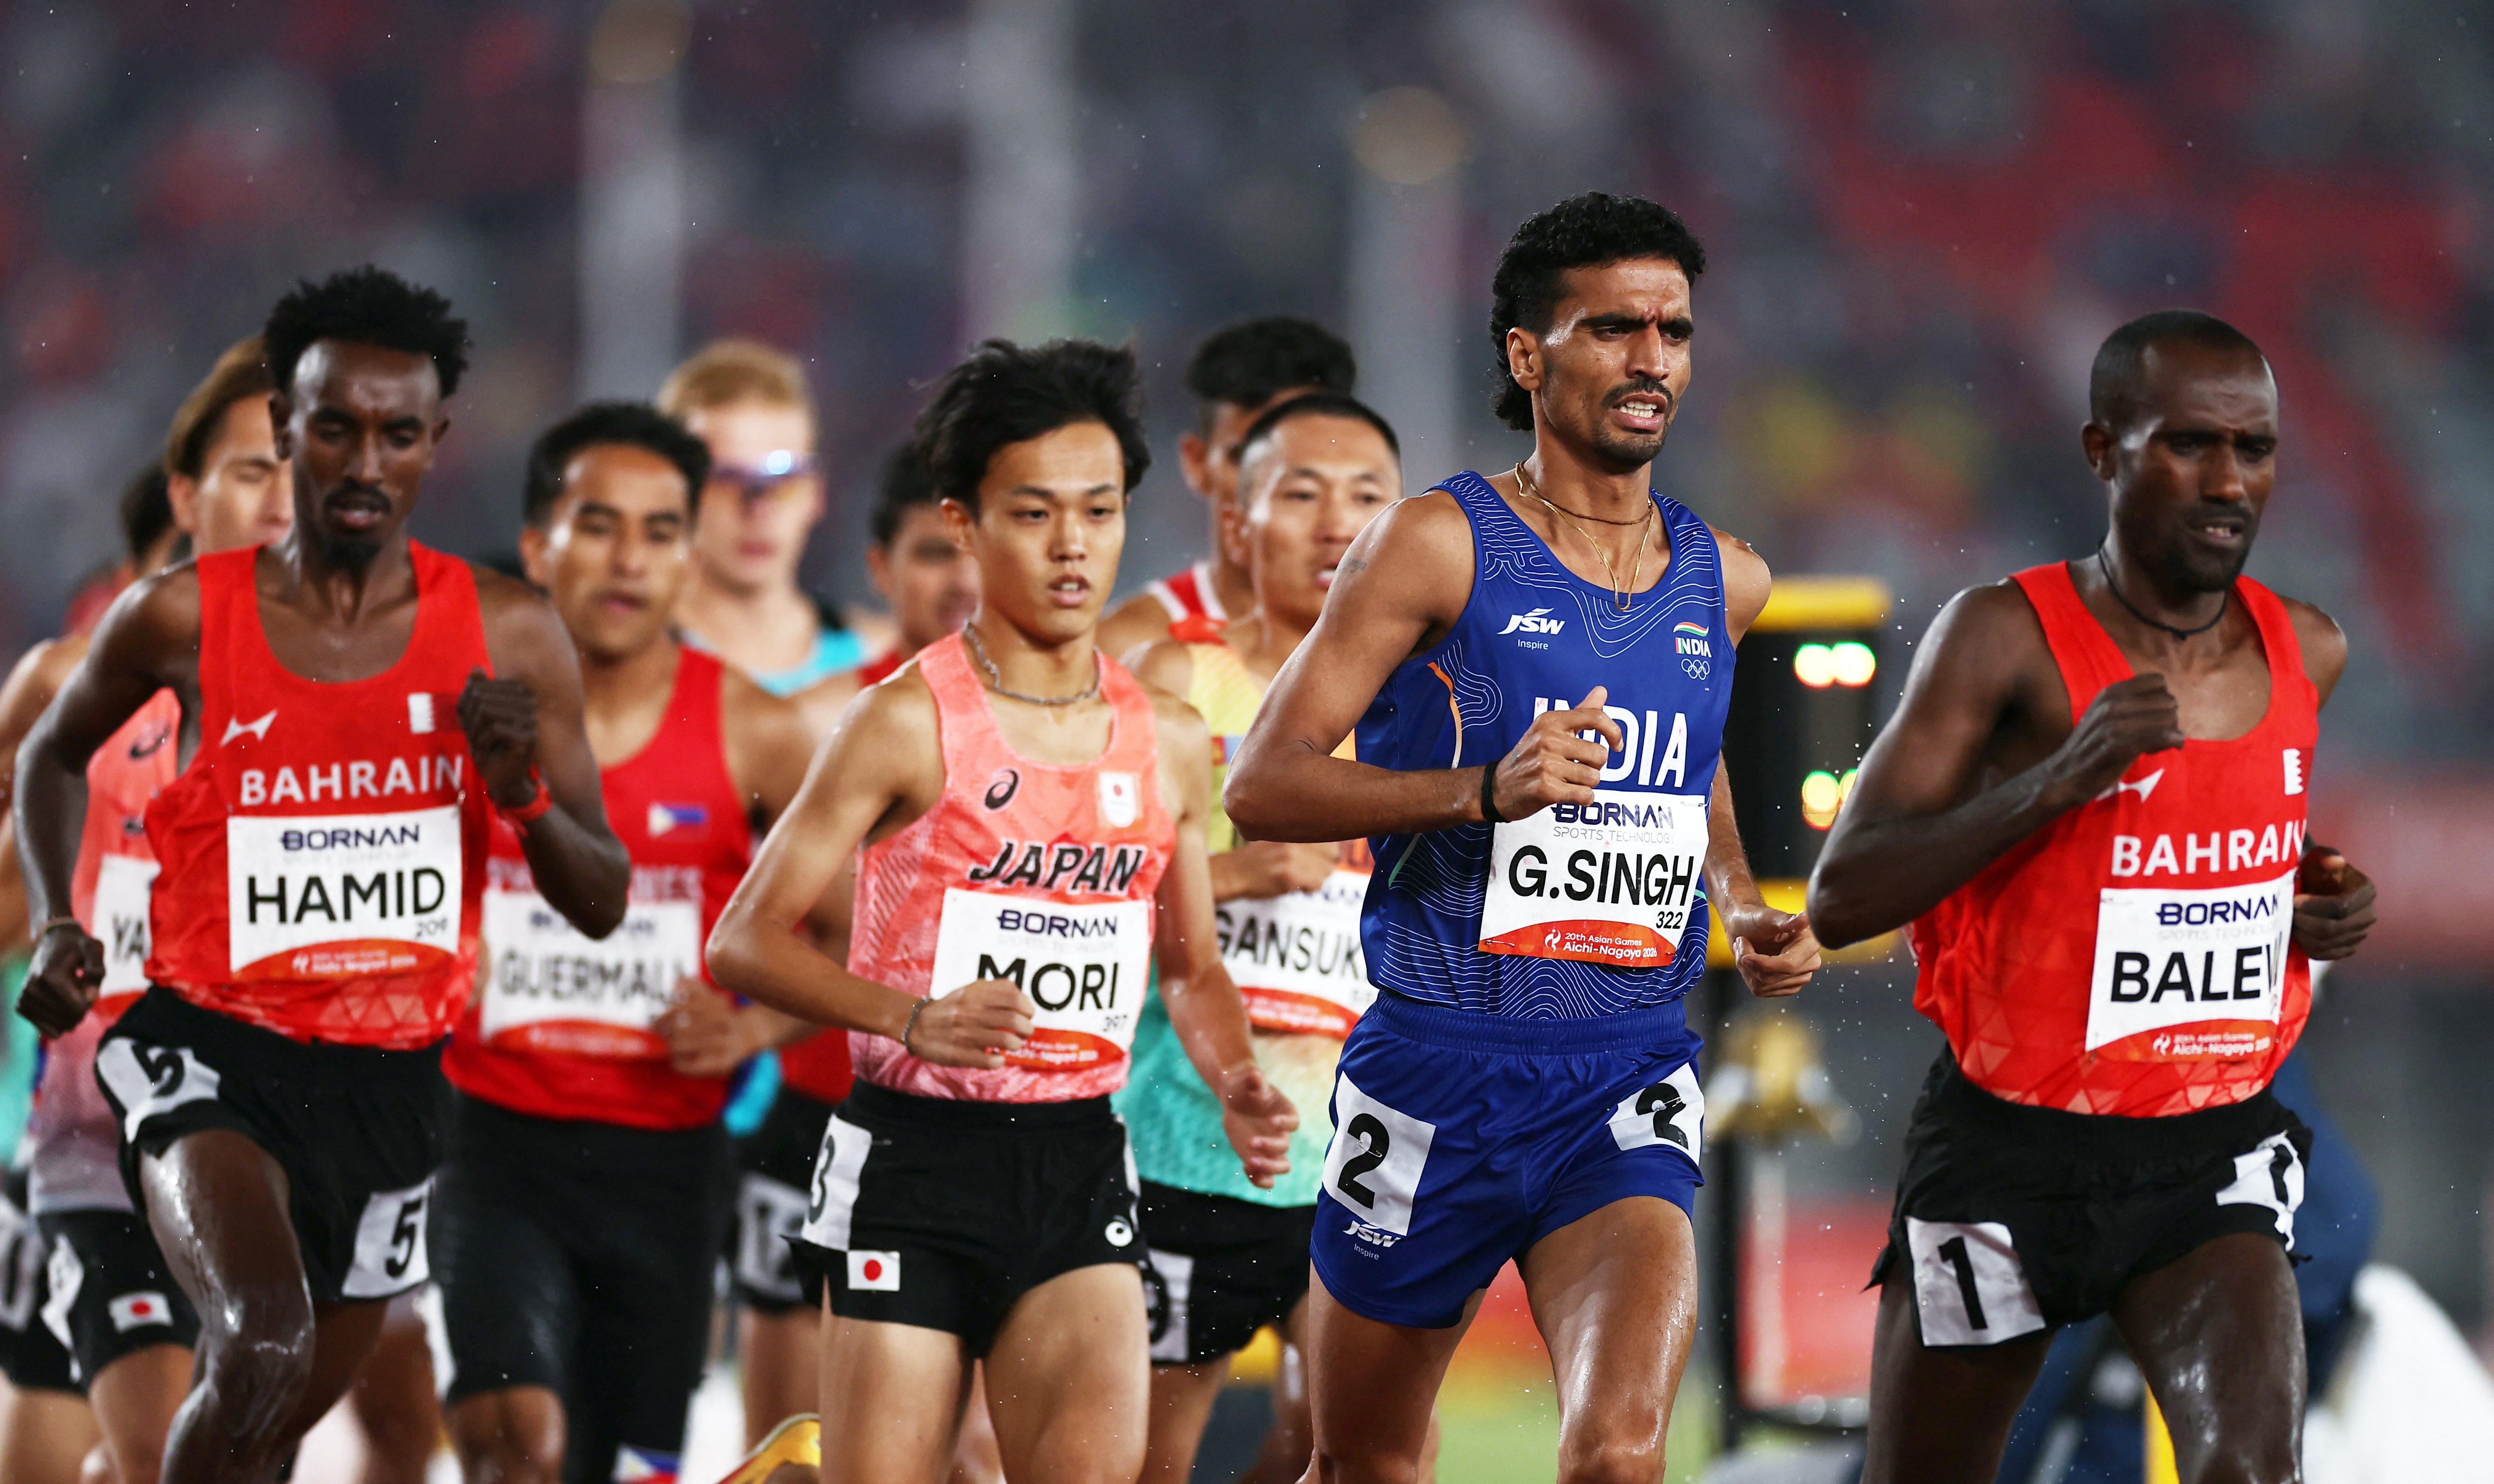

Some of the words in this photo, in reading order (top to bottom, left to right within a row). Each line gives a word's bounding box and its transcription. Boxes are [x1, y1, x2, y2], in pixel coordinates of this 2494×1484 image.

[1497, 614, 1565, 635] JSW
[1518, 639, 1549, 650] Inspire
[1675, 637, 1712, 658] INDIA
[1533, 697, 1687, 787] DIA
[240, 755, 462, 805] BAHRAIN
[1551, 802, 1673, 829] BORNAN
[280, 824, 419, 850] BORNAN
[1553, 826, 1603, 840] SPORTS
[1608, 830, 1675, 844] TECHNOLOGY
[2111, 818, 2307, 877] BAHRAIN
[968, 839, 1145, 894] JAPAN
[1509, 845, 1694, 906] G.SINGH
[248, 867, 444, 924] HAMID
[996, 909, 1117, 938] BORNAN
[1656, 911, 1683, 929] 322
[1563, 942, 1641, 960] Aichi-Nagoya
[1643, 947, 1657, 957] 2026
[1564, 932, 1586, 941] 20th
[1588, 935, 1612, 944] Asian
[1615, 937, 1643, 946] Games
[977, 954, 1119, 1012] MORI
[1636, 1082, 1689, 1150] 2
[1337, 1113, 1390, 1210] 2
[386, 1199, 423, 1277] 5
[1342, 1220, 1401, 1247] JSW
[1353, 1243, 1379, 1260] Inspire
[1938, 1237, 1988, 1330] 1
